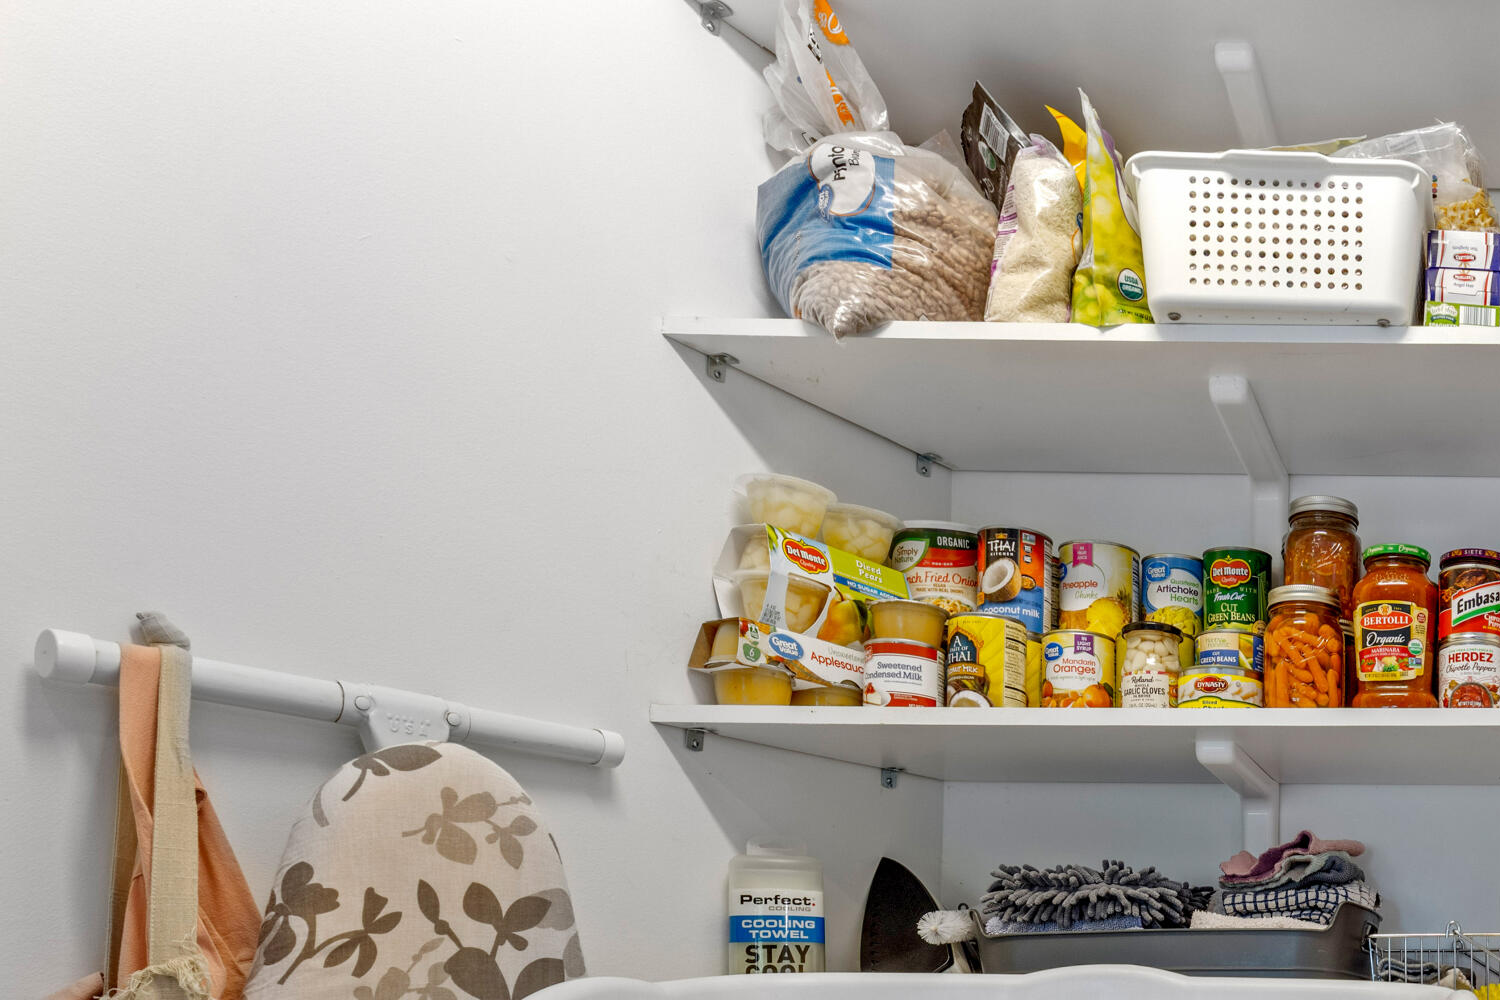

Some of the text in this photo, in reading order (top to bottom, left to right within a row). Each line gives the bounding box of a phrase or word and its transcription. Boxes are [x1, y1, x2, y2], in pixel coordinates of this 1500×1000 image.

[828, 146, 847, 182] Pinto
[936, 535, 971, 550] ORGANIC
[987, 539, 1017, 553] THAI
[786, 544, 827, 567] Del Monte
[896, 544, 919, 557] Simply
[855, 559, 882, 576] Diced
[1147, 566, 1166, 575] Great
[1212, 566, 1249, 577] Del Monte
[858, 568, 883, 584] Pears
[924, 570, 950, 584] Fried
[857, 582, 879, 595] SUGAR
[1062, 579, 1099, 590] Pineapple
[1156, 585, 1199, 597] Artichoke
[1170, 593, 1200, 605] Hearts
[1456, 591, 1500, 616] Embasa
[983, 606, 1041, 619] coconut milk
[1220, 603, 1239, 612] CUT
[1207, 610, 1256, 623] GREEN BEANS
[1363, 615, 1409, 627] BERTOLLI
[771, 636, 799, 650] Great
[953, 635, 963, 647] A
[1366, 631, 1406, 648] Organic
[749, 647, 755, 657] 6
[780, 644, 800, 658] Value
[1370, 646, 1401, 654] MARINARA
[810, 651, 865, 675] Applesauc
[1062, 658, 1097, 667] Mandarin
[1200, 655, 1237, 664] GREEN BEANS
[1448, 651, 1494, 664] HERDEZ
[877, 661, 923, 674] Sweetened
[962, 664, 979, 675] MILK
[1053, 663, 1097, 676] Oranges
[1445, 661, 1497, 674] Chipotle Peppers
[902, 672, 923, 682] Milk
[1130, 675, 1155, 684] Roland
[1123, 686, 1166, 696] GARLIC CLOVES
[1196, 680, 1226, 690] DYNASTY
[741, 919, 816, 930] COOLING
[748, 929, 809, 940] TOWEL
[744, 944, 811, 964] STAY
